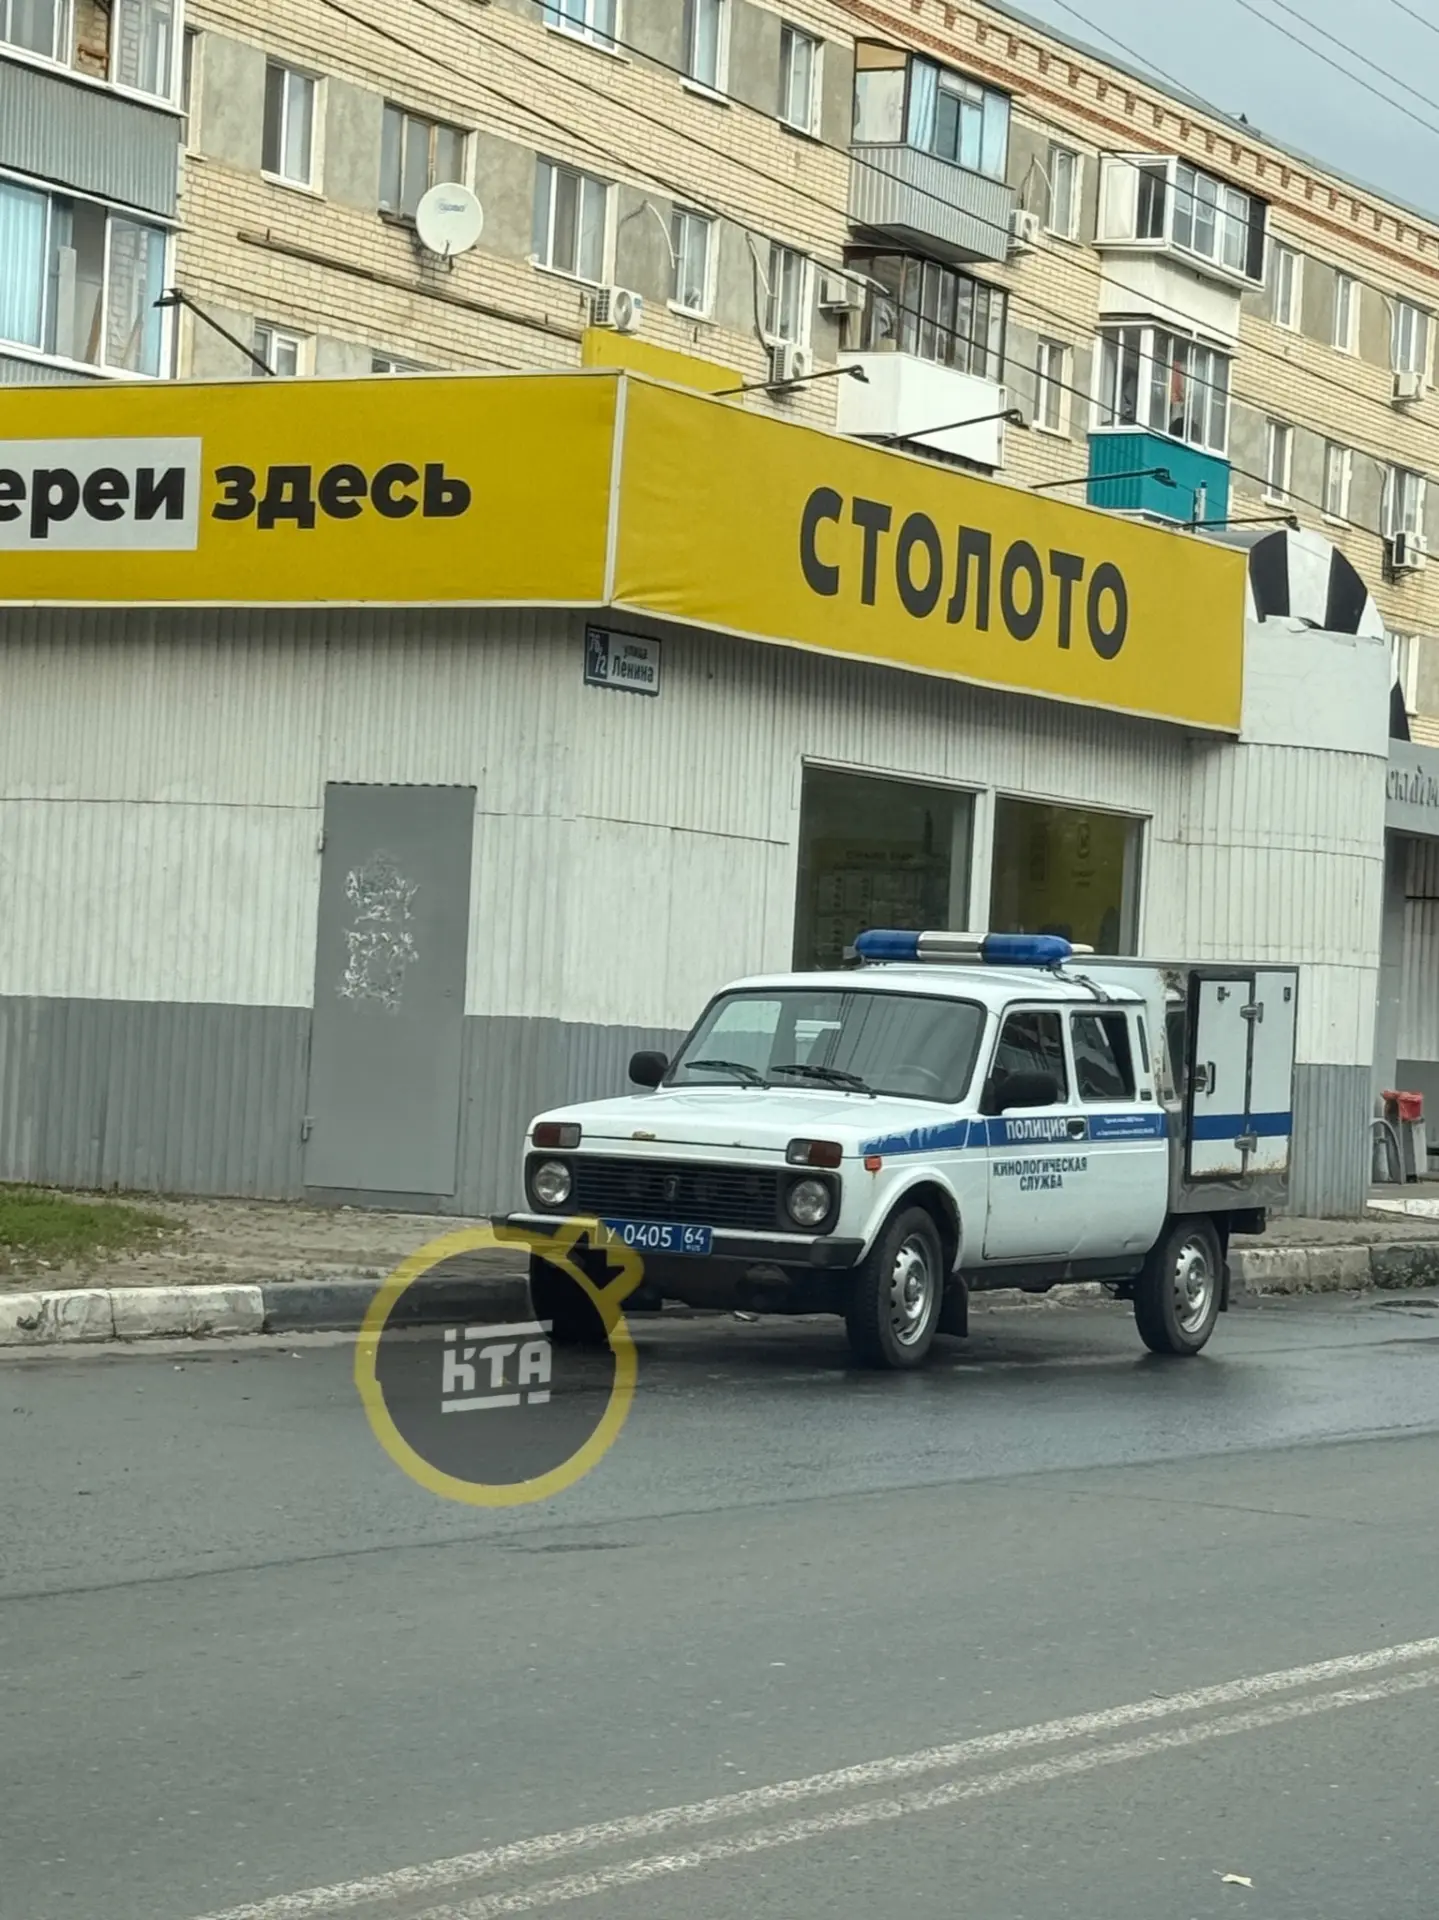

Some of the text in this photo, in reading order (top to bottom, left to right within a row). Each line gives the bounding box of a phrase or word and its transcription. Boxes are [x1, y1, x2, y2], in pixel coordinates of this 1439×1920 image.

[211, 463, 471, 529] здесь
[800, 486, 1129, 660] СТОЛОТО
[611, 655, 654, 683] Ленина
[1005, 1117, 1068, 1140] ПОЛИЦИЯ
[992, 1157, 1088, 1176] КИНОЛОГИЧЕСКАЯ
[1019, 1174, 1063, 1191] СЛУЖБА
[624, 1224, 673, 1247] 0405
[684, 1227, 704, 1245] 64
